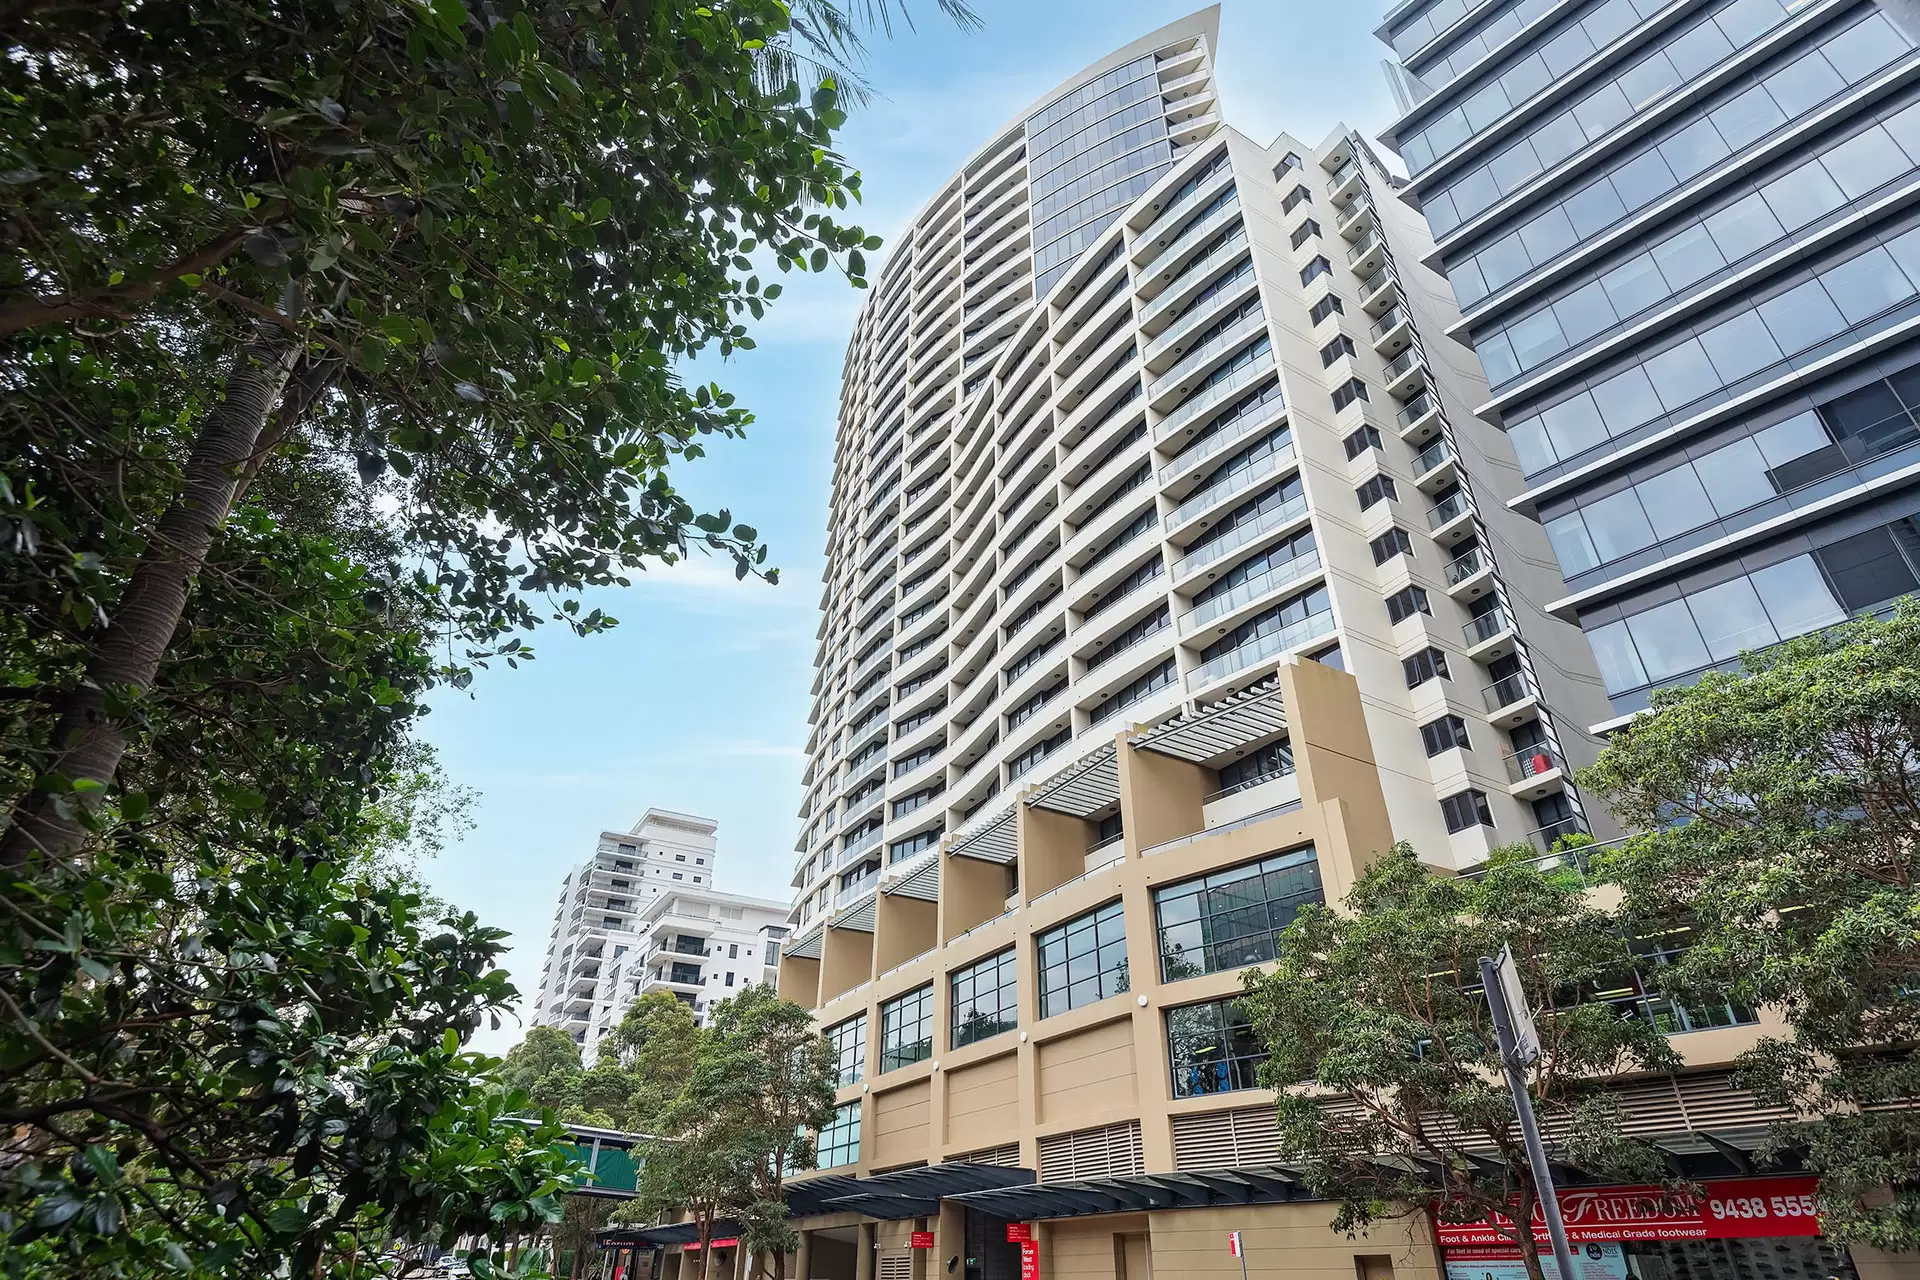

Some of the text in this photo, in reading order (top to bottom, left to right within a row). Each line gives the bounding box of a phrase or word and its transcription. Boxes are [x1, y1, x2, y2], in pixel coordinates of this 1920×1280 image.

[1562, 1192, 1701, 1223] FREEDOM
[1709, 1195, 1828, 1220] 9438 555
[1440, 1234, 1460, 1243] Foot
[1471, 1233, 1496, 1242] Ankle
[1572, 1231, 1580, 1240] &
[1581, 1230, 1621, 1240] Medical
[1623, 1229, 1656, 1238] Grade
[1657, 1228, 1708, 1237] footwear
